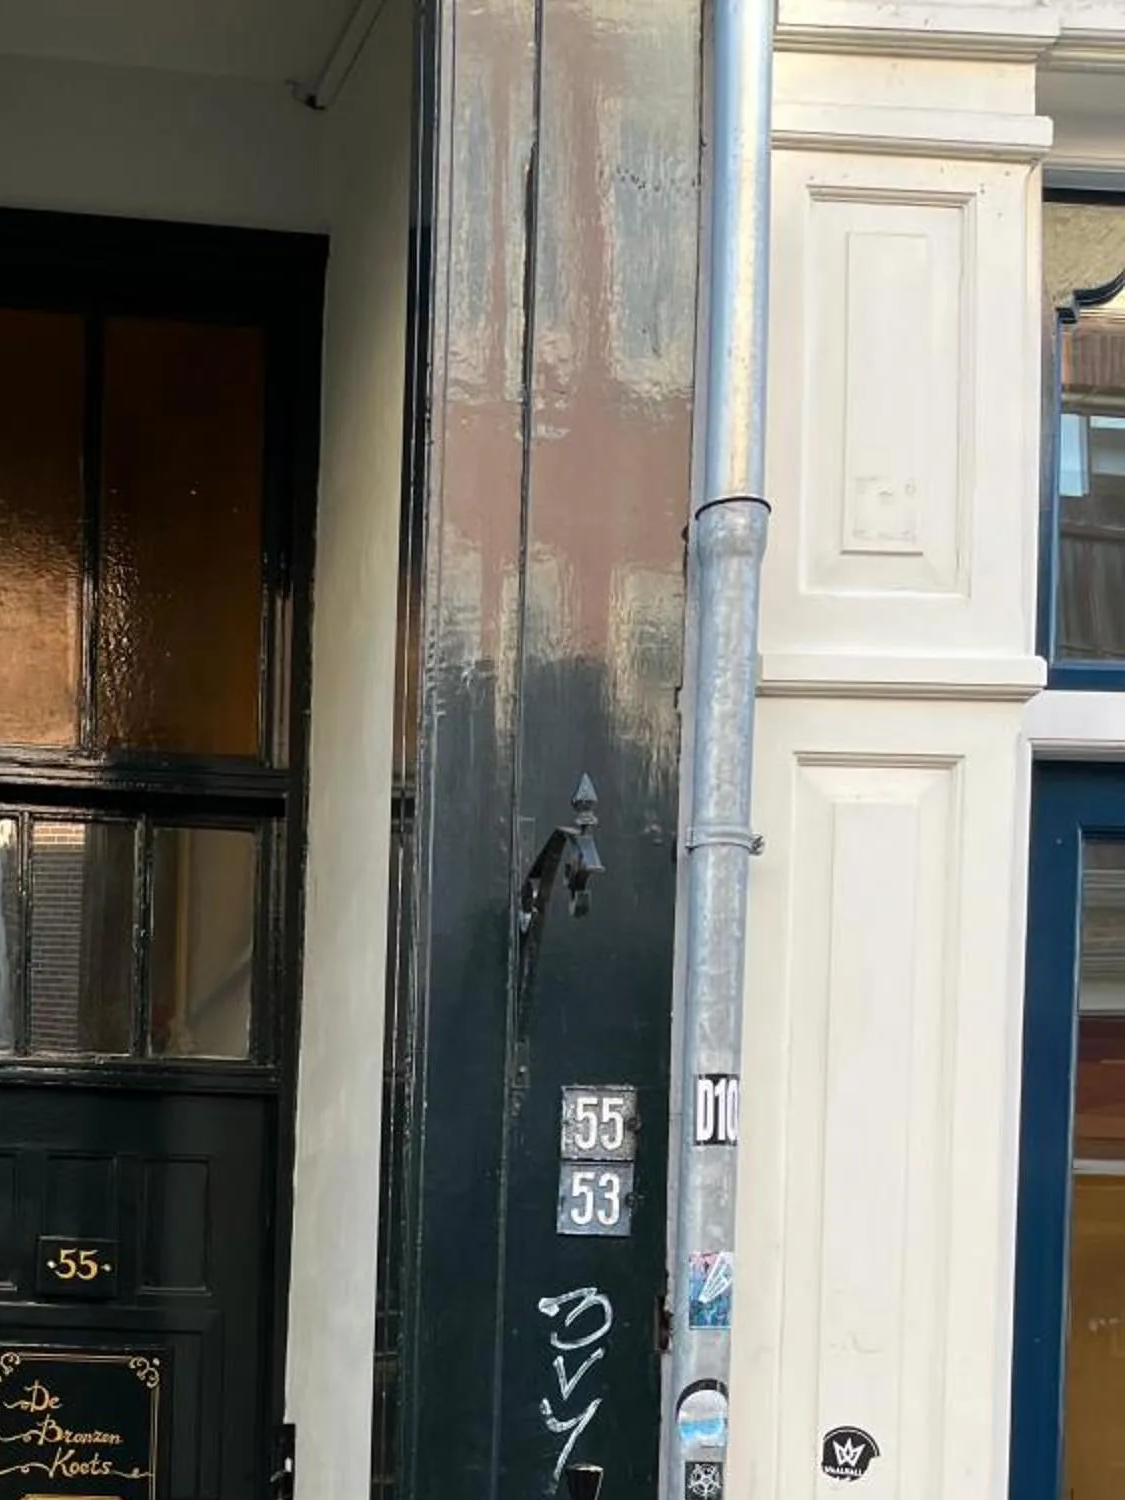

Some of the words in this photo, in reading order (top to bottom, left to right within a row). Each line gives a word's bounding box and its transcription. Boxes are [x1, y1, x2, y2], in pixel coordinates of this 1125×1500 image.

[575, 1096, 625, 1151] 55
[570, 1170, 621, 1226] 53
[55, 1247, 99, 1281] 55
[25, 1378, 63, 1413] De
[37, 1413, 124, 1446] Bronzen
[48, 1446, 114, 1479] Koets
